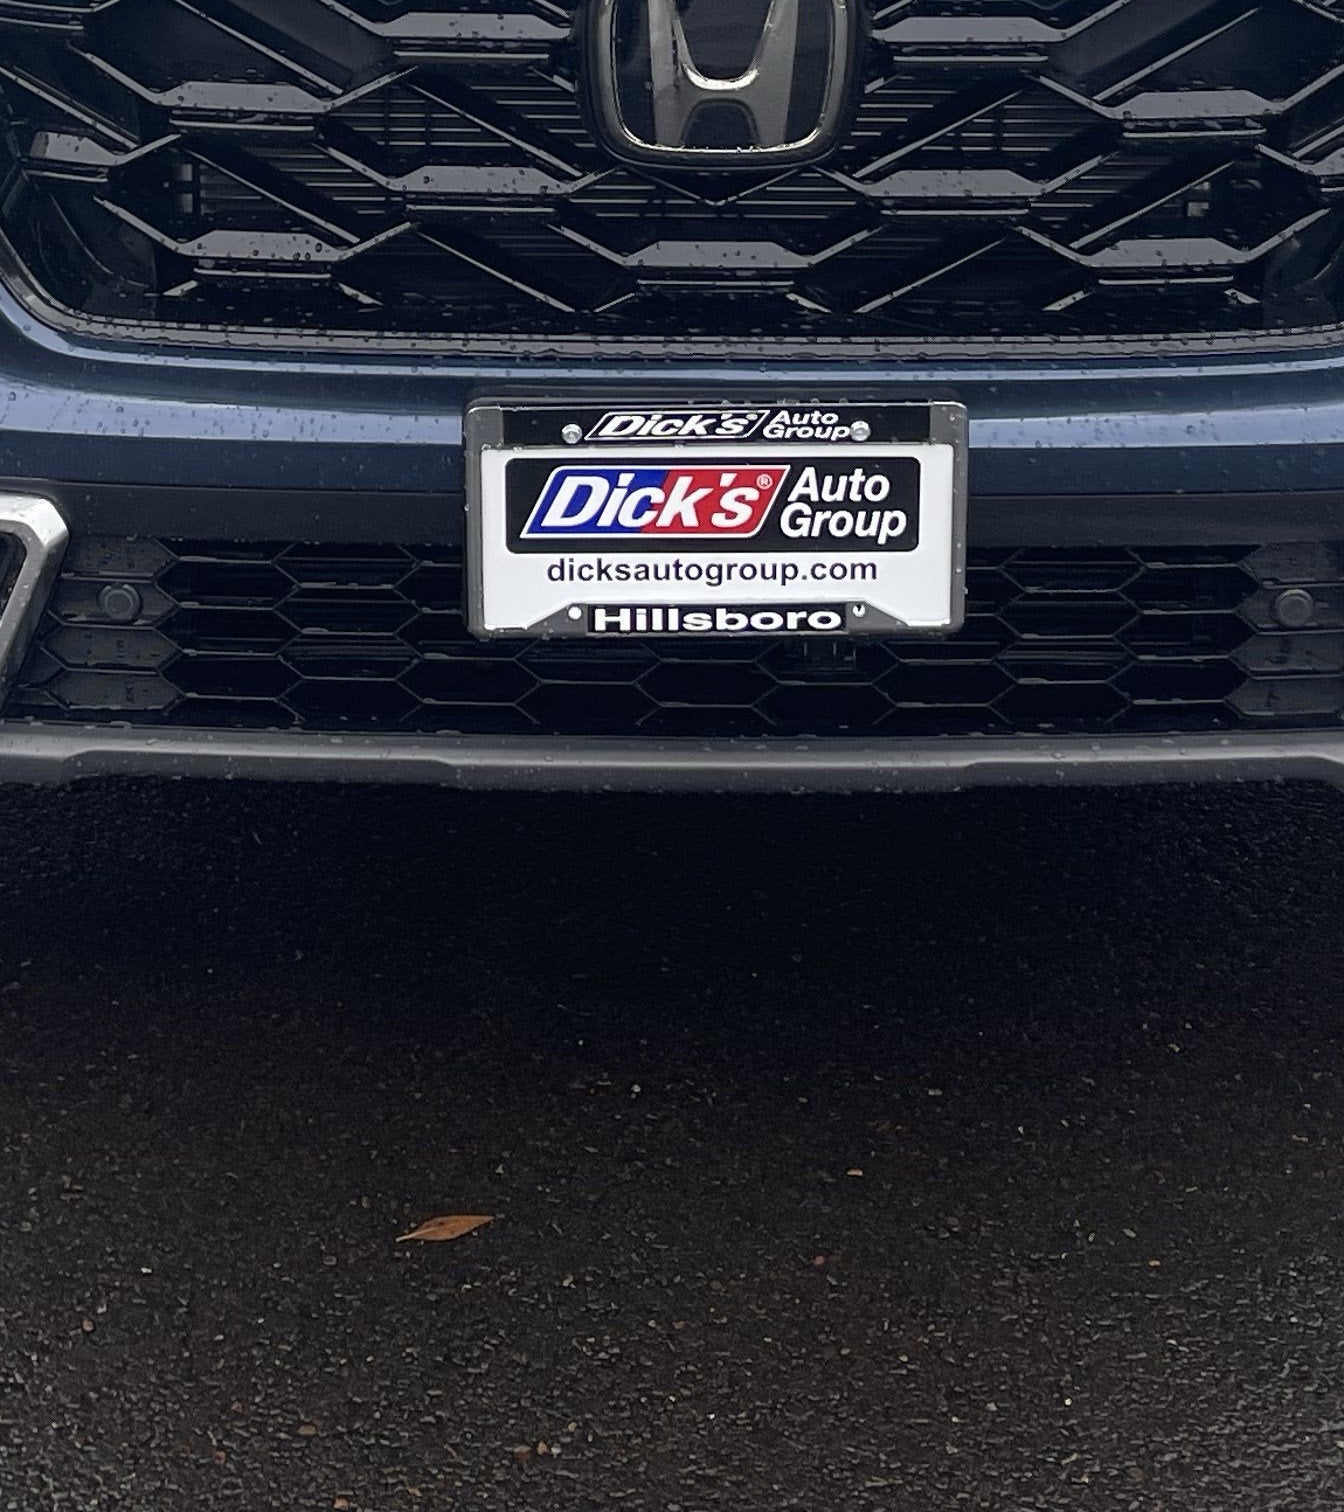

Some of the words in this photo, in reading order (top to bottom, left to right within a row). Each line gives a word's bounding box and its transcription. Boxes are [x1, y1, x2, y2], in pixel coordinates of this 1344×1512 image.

[767, 409, 840, 425] Auto
[762, 423, 852, 442] Group
[787, 466, 892, 503] Auto
[540, 471, 761, 529] Dick's
[779, 502, 908, 546] Group
[546, 557, 879, 587] dicksautogroup.com
[592, 606, 843, 633] Hillsboro
